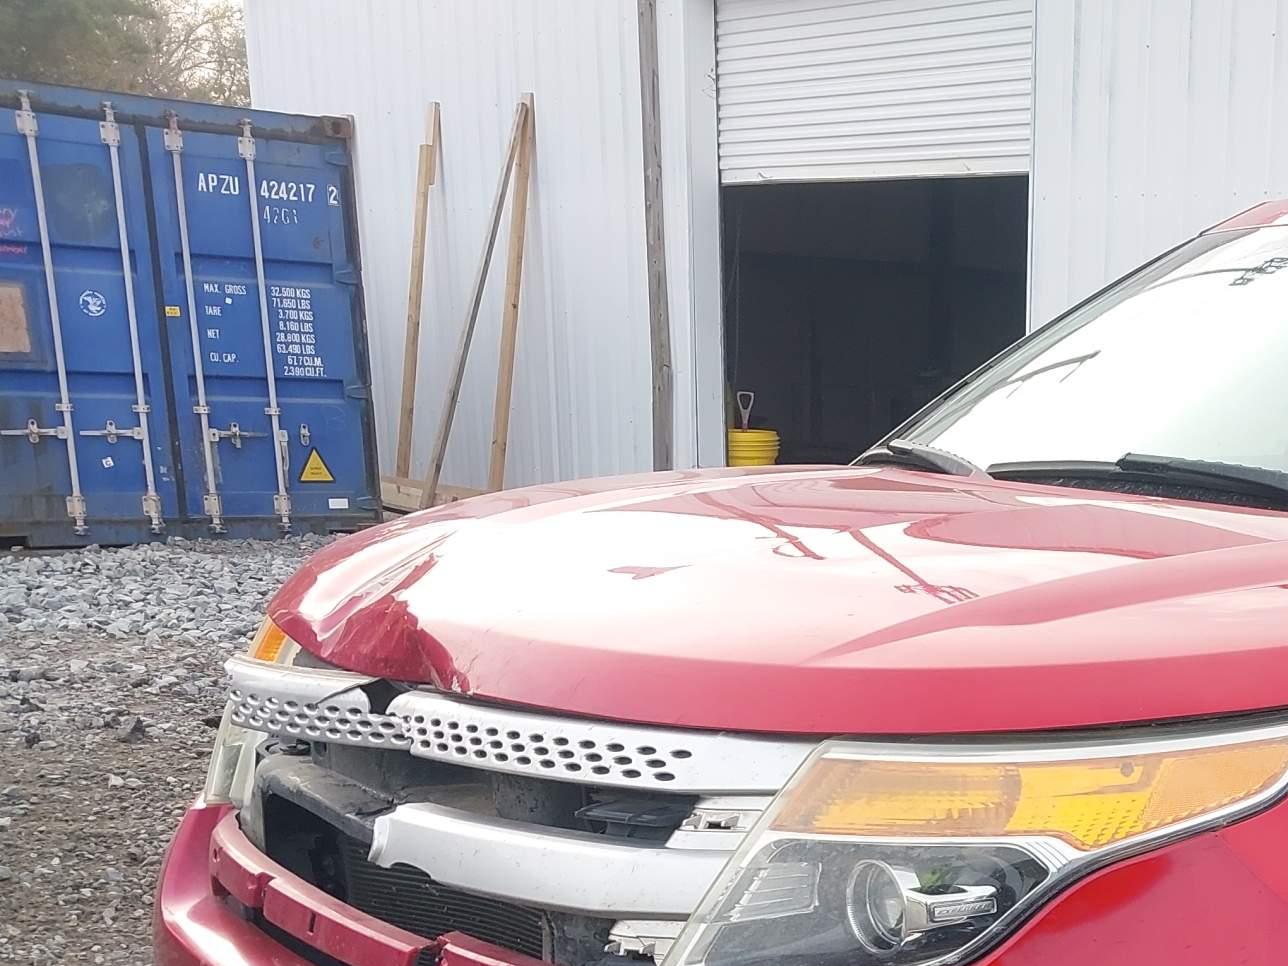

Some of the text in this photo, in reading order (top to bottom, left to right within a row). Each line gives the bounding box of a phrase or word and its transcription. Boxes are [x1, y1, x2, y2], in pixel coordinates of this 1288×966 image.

[198, 173, 339, 205] APZU 424217 2
[224, 284, 247, 295] GROSS
[296, 288, 311, 299] KGS
[297, 299, 311, 310] LBS
[205, 306, 222, 316] TARE
[299, 310, 314, 321] KGS
[300, 322, 313, 332] LBS
[207, 329, 219, 339] NET
[301, 333, 316, 344] KGS
[302, 345, 316, 355] LBS
